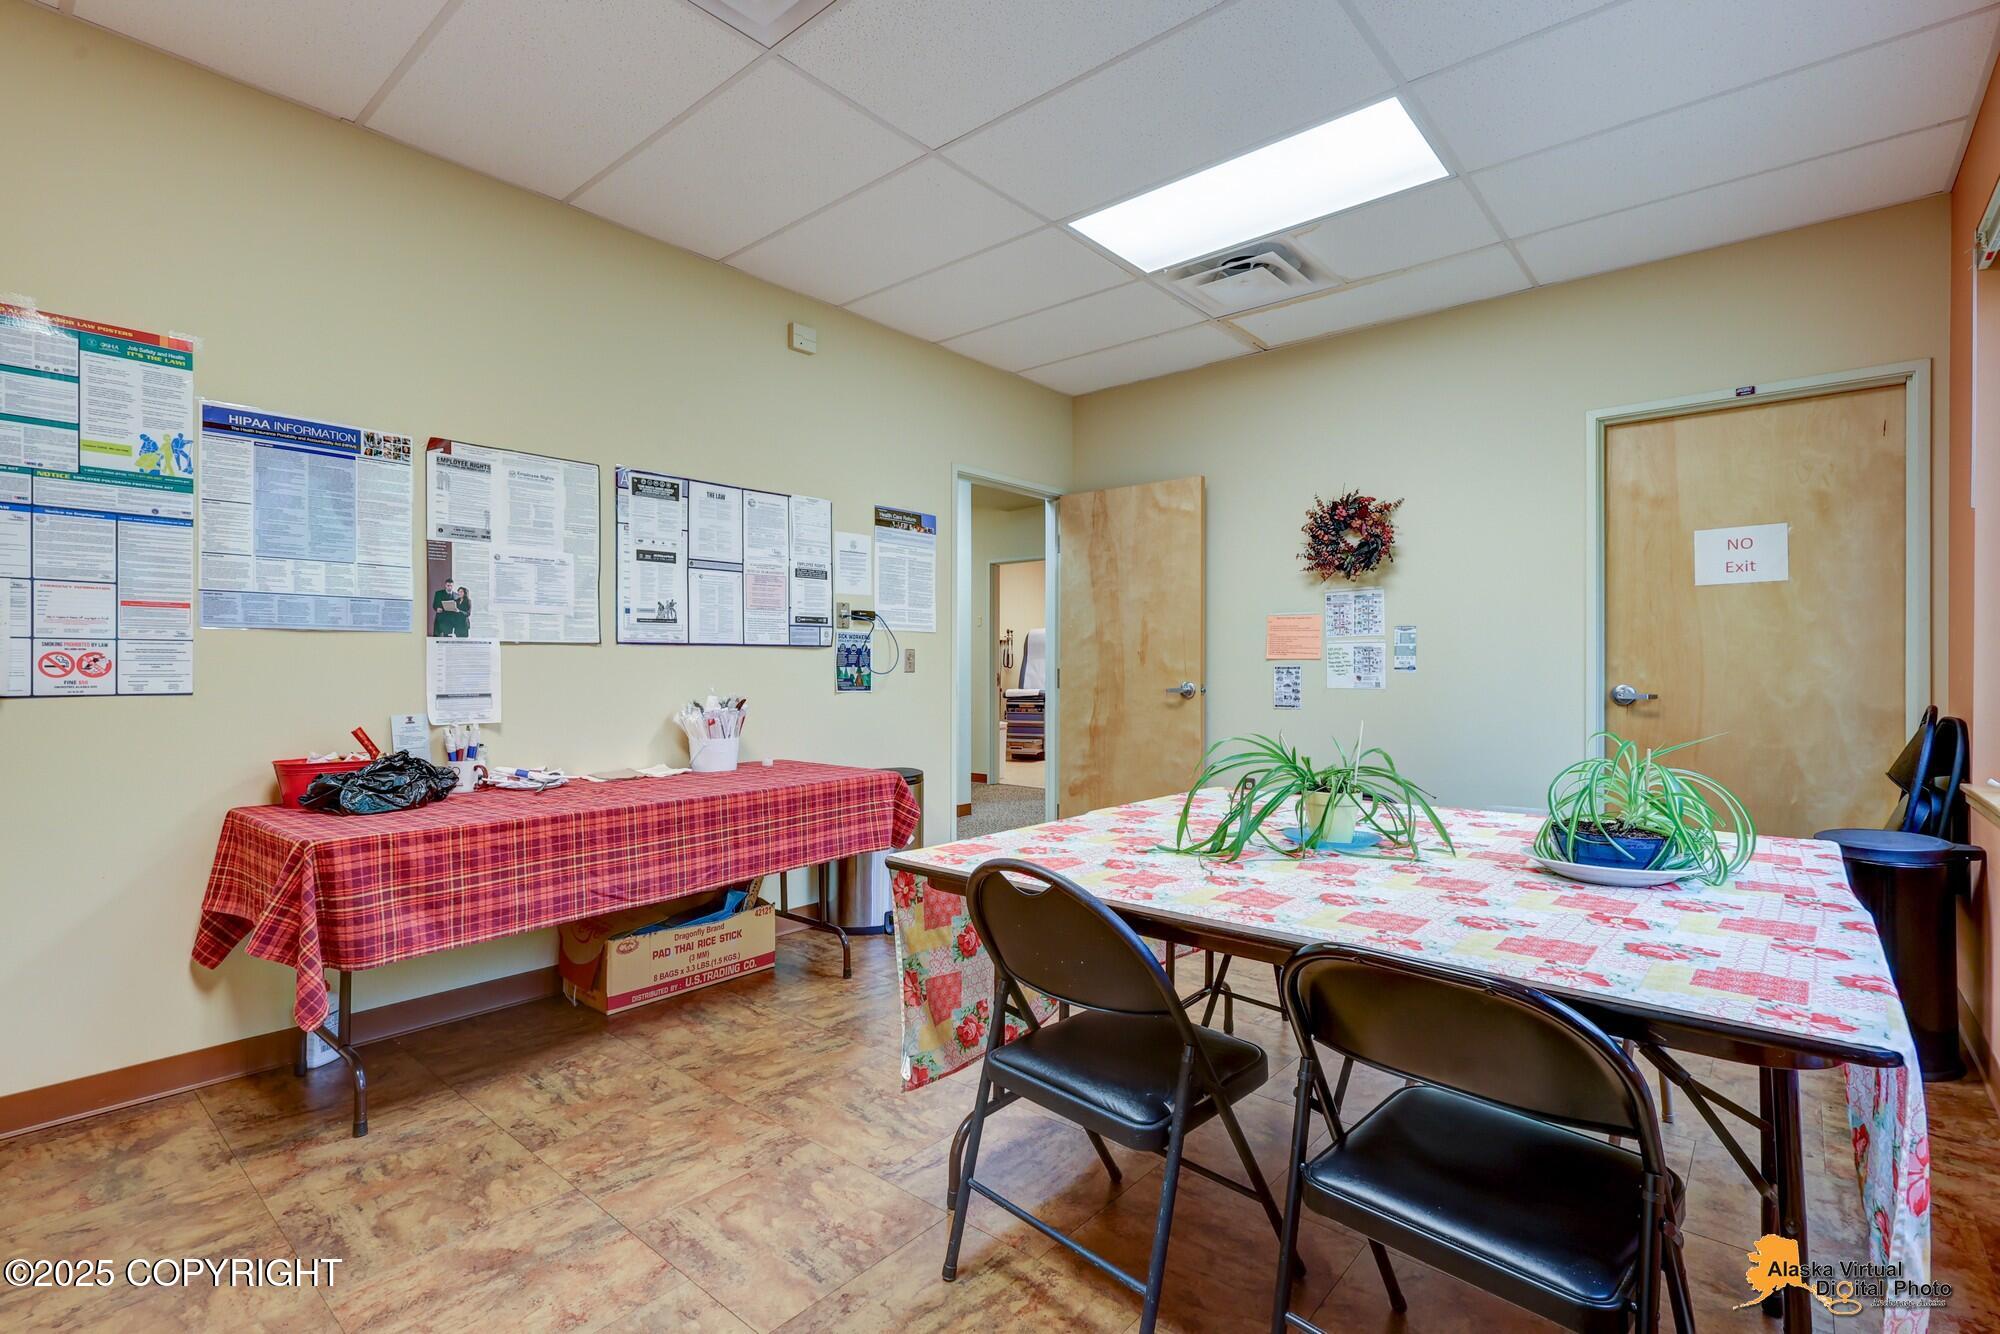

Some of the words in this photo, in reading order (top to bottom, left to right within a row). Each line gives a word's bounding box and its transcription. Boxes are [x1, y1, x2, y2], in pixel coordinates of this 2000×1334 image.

[77, 321, 96, 330] LAW
[97, 325, 134, 338] POSTERS
[139, 348, 156, 356] Safety
[228, 414, 270, 430] HIPAA
[274, 422, 356, 443] INFORMATION
[276, 432, 298, 440] Portability
[436, 456, 468, 466] EMPLOYEE
[470, 462, 491, 470] RIGHTS
[36, 470, 70, 480] NOTICE
[716, 492, 726, 500] LAW
[1727, 537, 1753, 550] NO
[1726, 560, 1756, 573] Exit
[754, 906, 772, 917] 42121
[674, 928, 705, 941] Dragonfly
[706, 922, 725, 934] Brand
[652, 948, 671, 960] PAD
[674, 942, 694, 954] THAI
[697, 936, 716, 948] RICE
[720, 929, 742, 942] STICK
[688, 954, 695, 963] (3
[696, 950, 710, 960] MM)
[660, 969, 679, 981] BAGS
[686, 964, 696, 973] 3.3
[632, 987, 669, 1003] DISTRIBUTED
[743, 959, 757, 970] CO.
